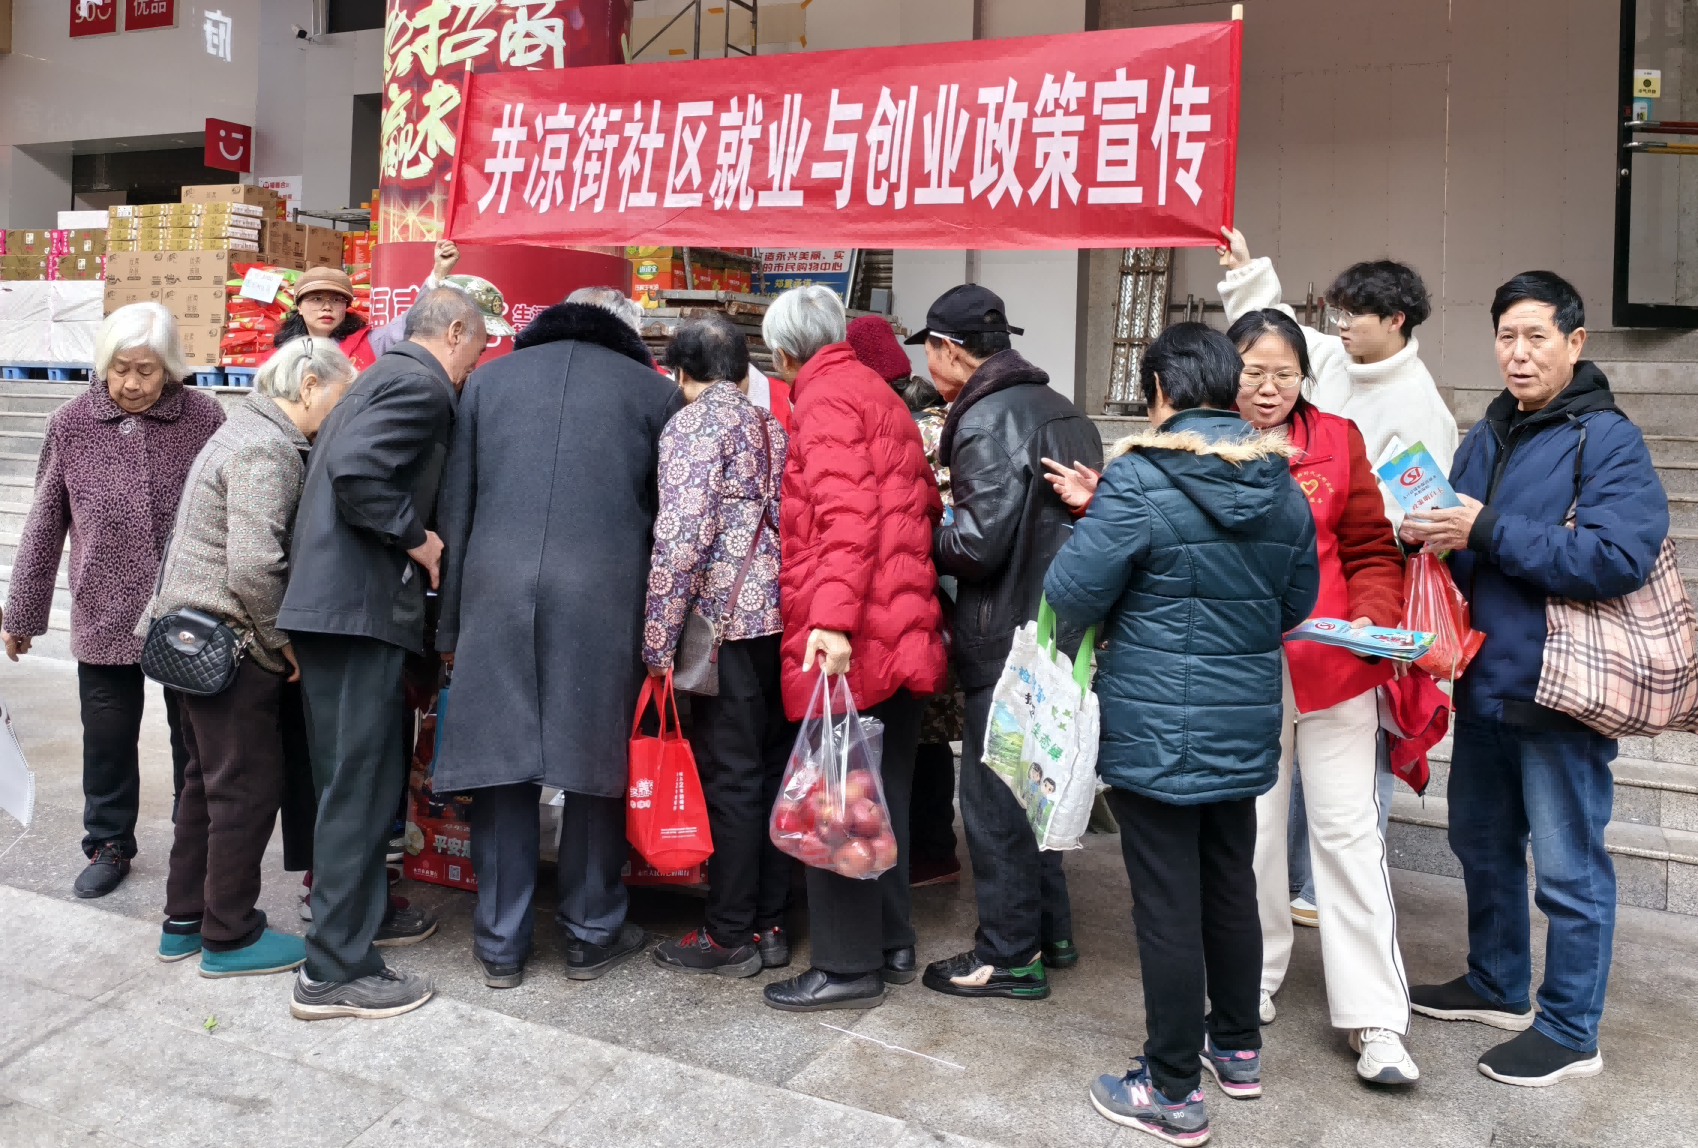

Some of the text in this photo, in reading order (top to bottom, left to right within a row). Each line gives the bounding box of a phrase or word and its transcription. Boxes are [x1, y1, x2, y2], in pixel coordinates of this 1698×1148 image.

[477, 64, 1212, 215] 井凉街社区就业与创业政策宣传
